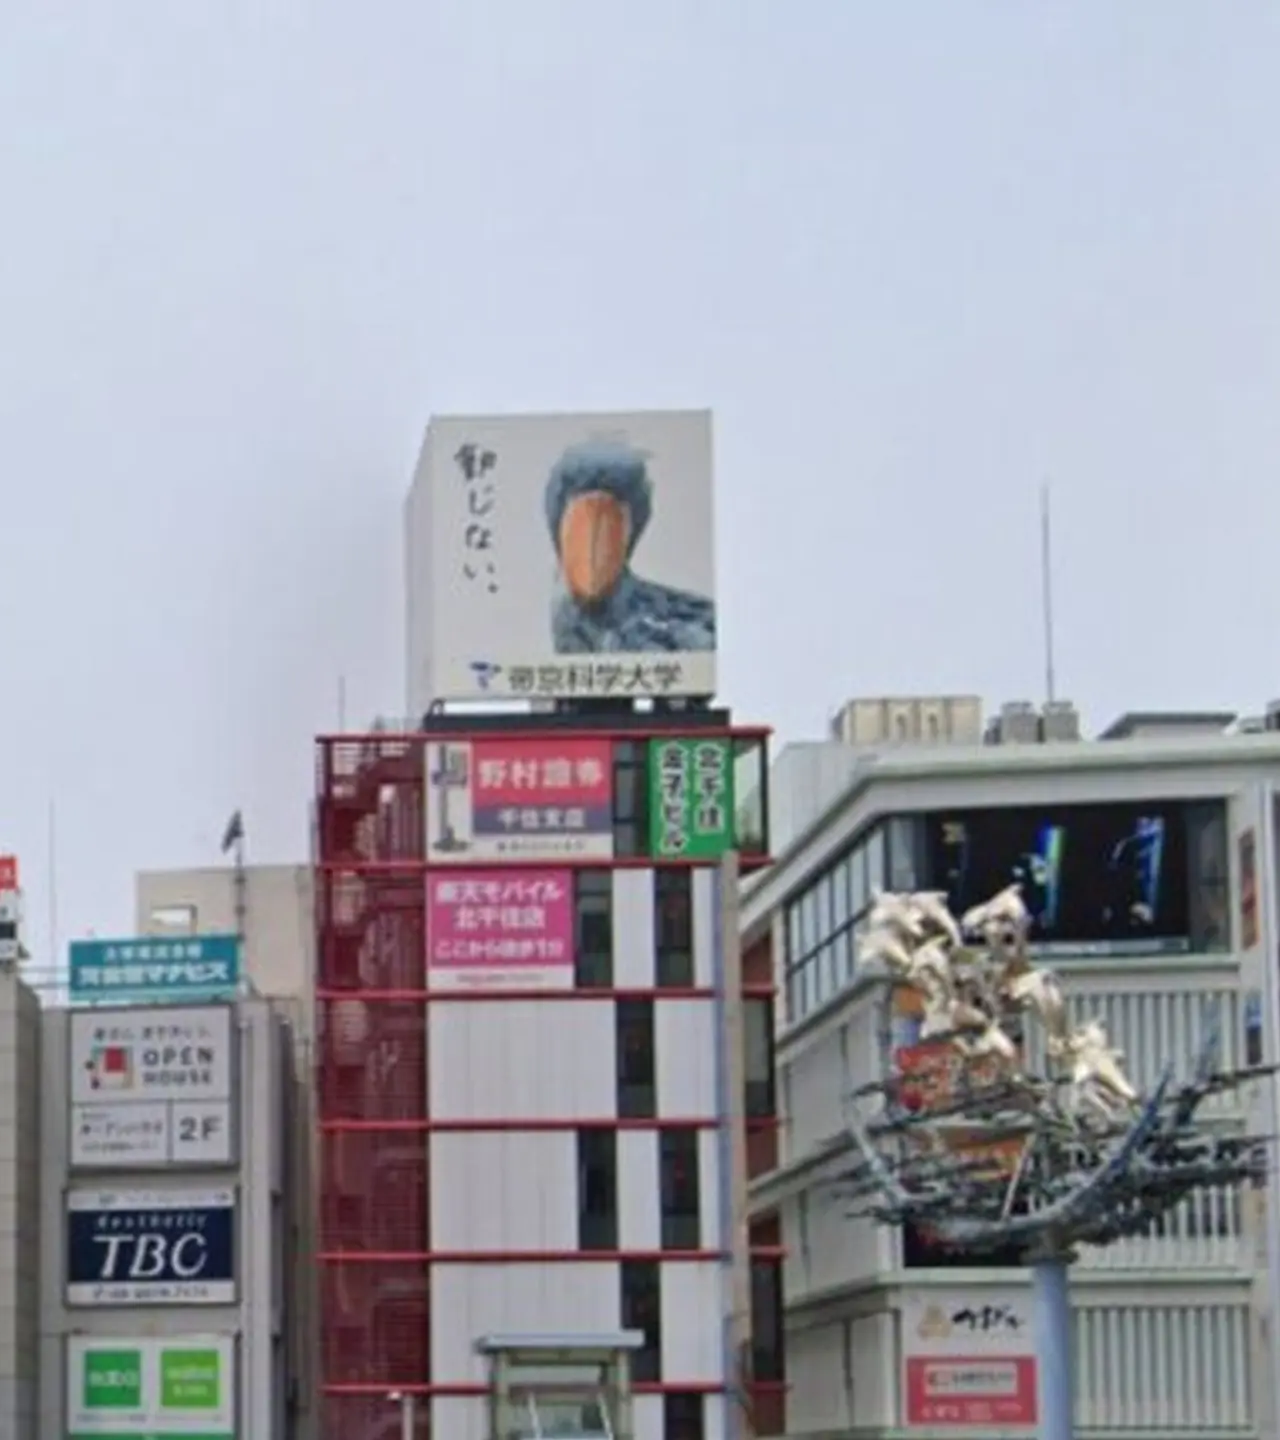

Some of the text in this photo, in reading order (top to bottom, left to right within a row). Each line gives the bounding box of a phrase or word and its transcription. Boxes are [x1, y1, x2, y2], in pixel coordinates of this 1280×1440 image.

[508, 664, 682, 691] 帝京科学大学
[435, 880, 563, 903] 楽天モバイル
[455, 906, 546, 929] 北千住店
[143, 1046, 213, 1067] OPEN
[143, 1070, 212, 1086] HOUSE
[179, 1115, 223, 1142] 2F
[92, 1232, 208, 1279] TBC
